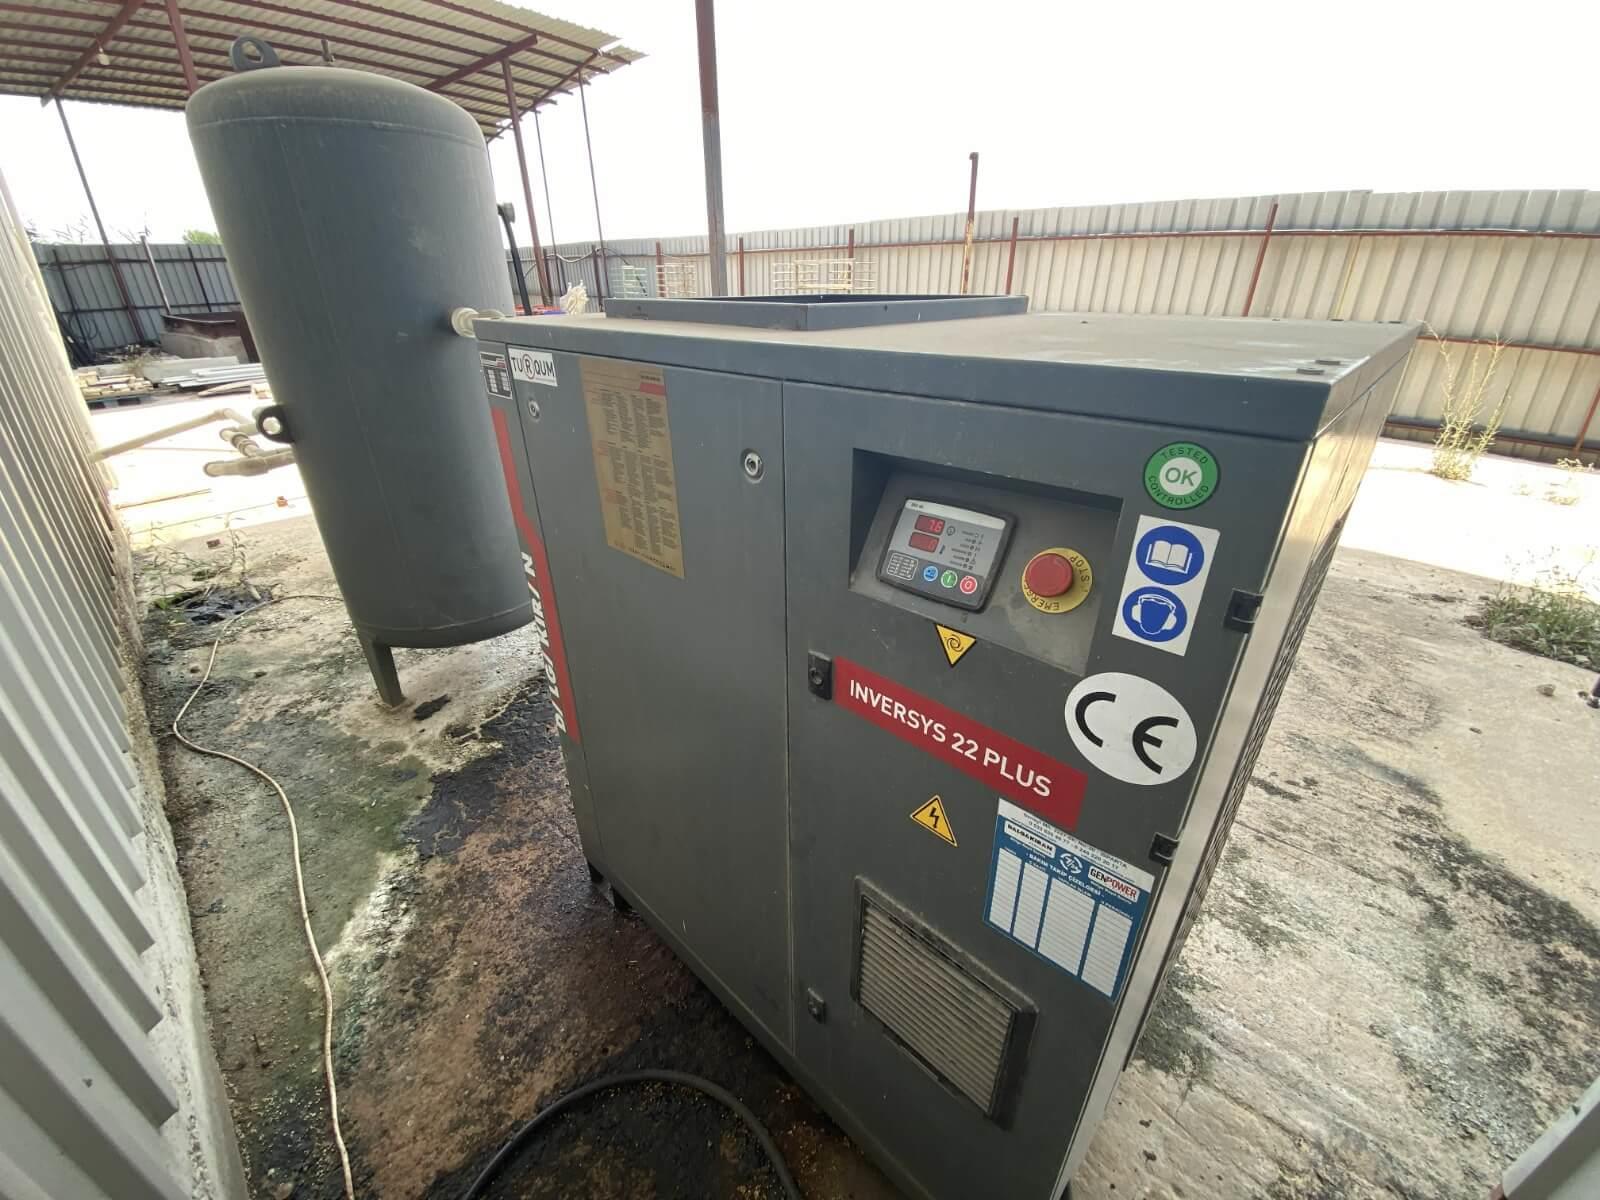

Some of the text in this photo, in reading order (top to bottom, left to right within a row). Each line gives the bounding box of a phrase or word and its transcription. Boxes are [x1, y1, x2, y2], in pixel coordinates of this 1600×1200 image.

[511, 354, 555, 379] TURQUM
[1160, 447, 1209, 464] TESTED
[1165, 467, 1198, 487] OK
[1148, 475, 1209, 506] CONTROLLED
[1069, 556, 1090, 582] STOP
[850, 679, 1052, 798] INVERSYS 22 PLUS
[1090, 868, 1137, 898] GENPOWER
